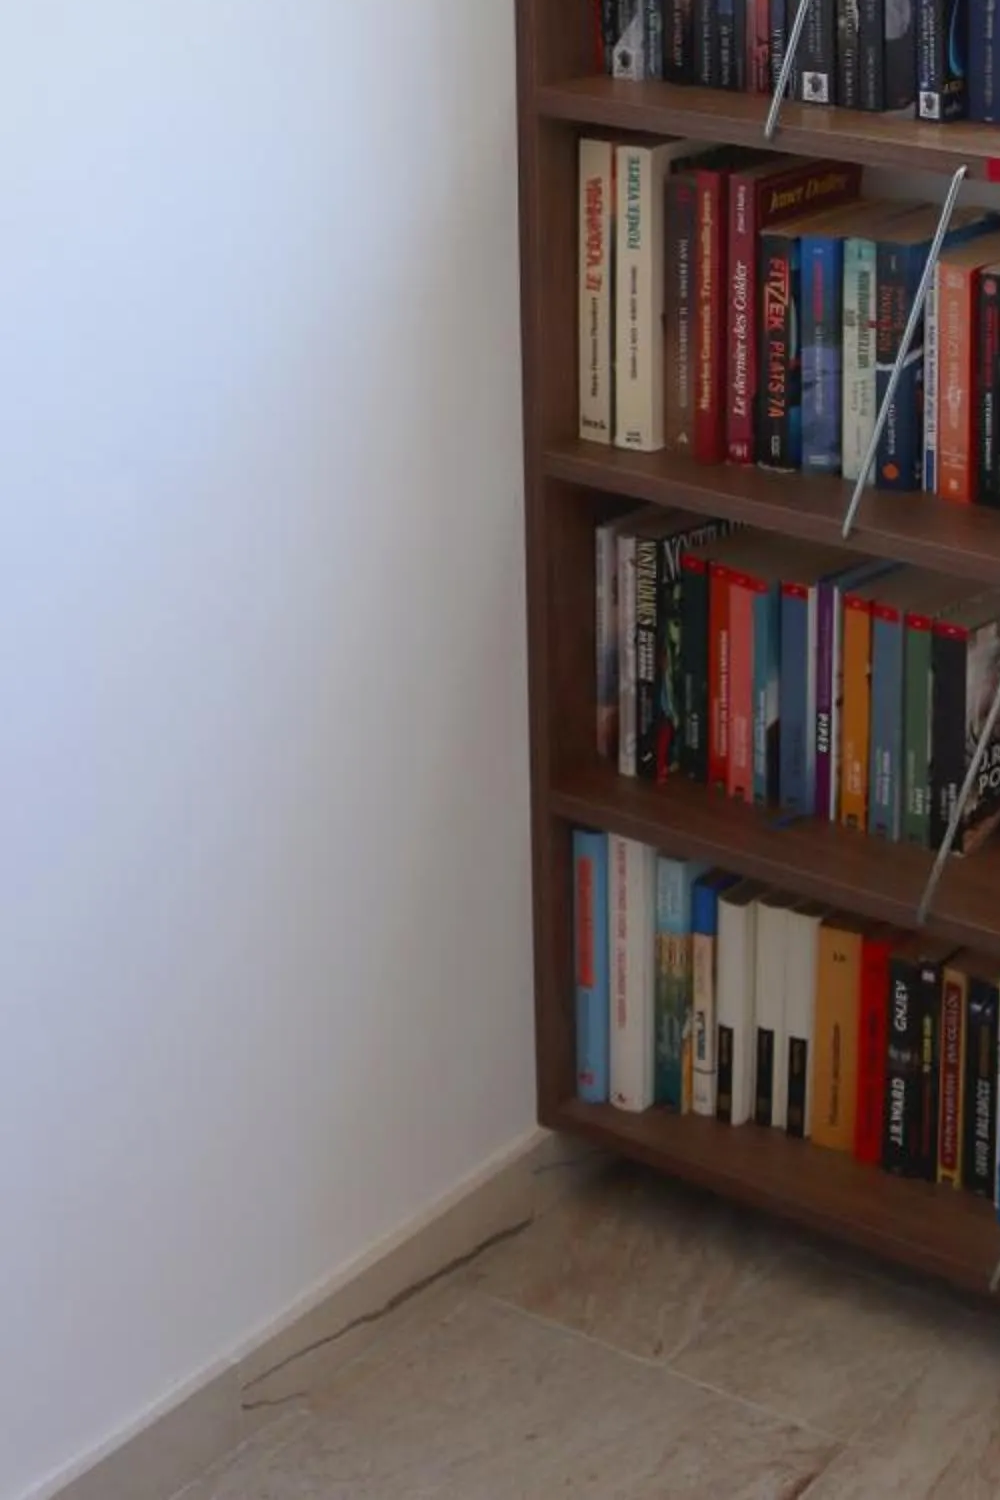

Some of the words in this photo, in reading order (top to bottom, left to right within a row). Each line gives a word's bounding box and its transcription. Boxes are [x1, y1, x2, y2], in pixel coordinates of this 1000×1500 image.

[765, 257, 789, 332] FITZEK
[733, 314, 748, 340] des
[733, 341, 748, 394] dernier
[733, 395, 747, 416] Le
[768, 396, 786, 419] 7A
[817, 712, 829, 755] PIPER
[894, 980, 908, 1032] GNJEV
[973, 1141, 989, 1176] DAVID
